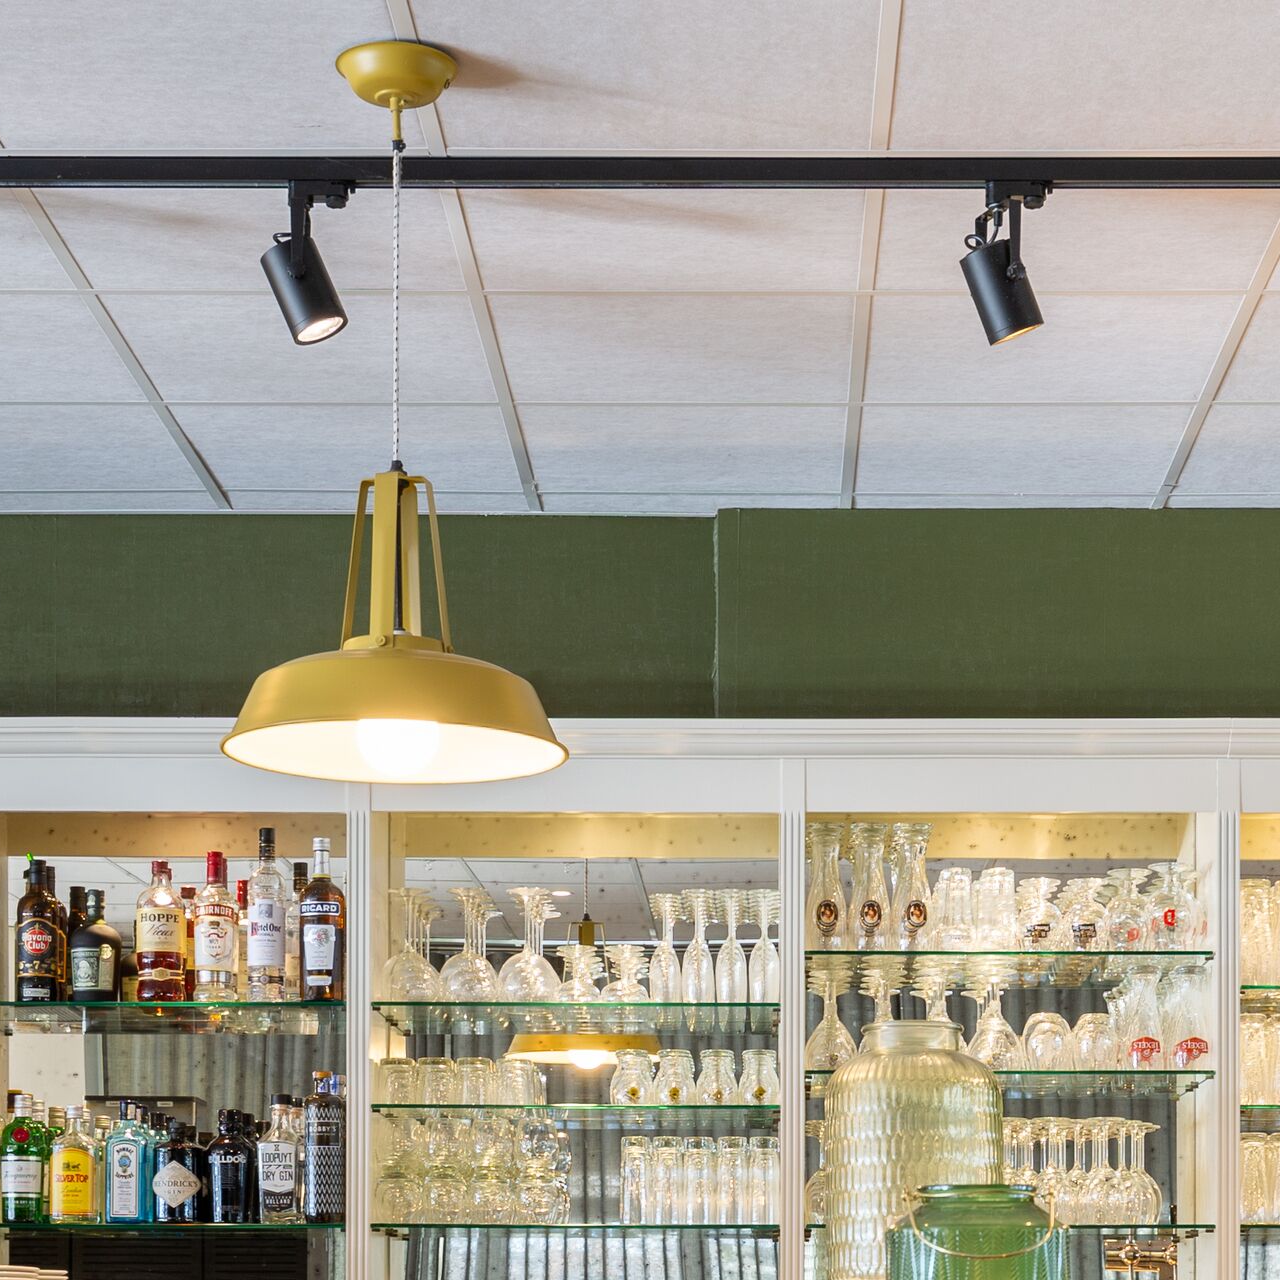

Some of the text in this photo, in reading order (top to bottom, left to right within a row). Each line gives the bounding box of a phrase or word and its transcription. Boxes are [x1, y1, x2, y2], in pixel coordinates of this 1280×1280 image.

[302, 904, 337, 912] RICARD
[141, 914, 179, 923] HOPPE
[28, 941, 46, 950] Club
[208, 1154, 247, 1164] BULLDOG
[75, 1173, 89, 1183] TOP
[262, 1171, 294, 1181] DRY GIN
